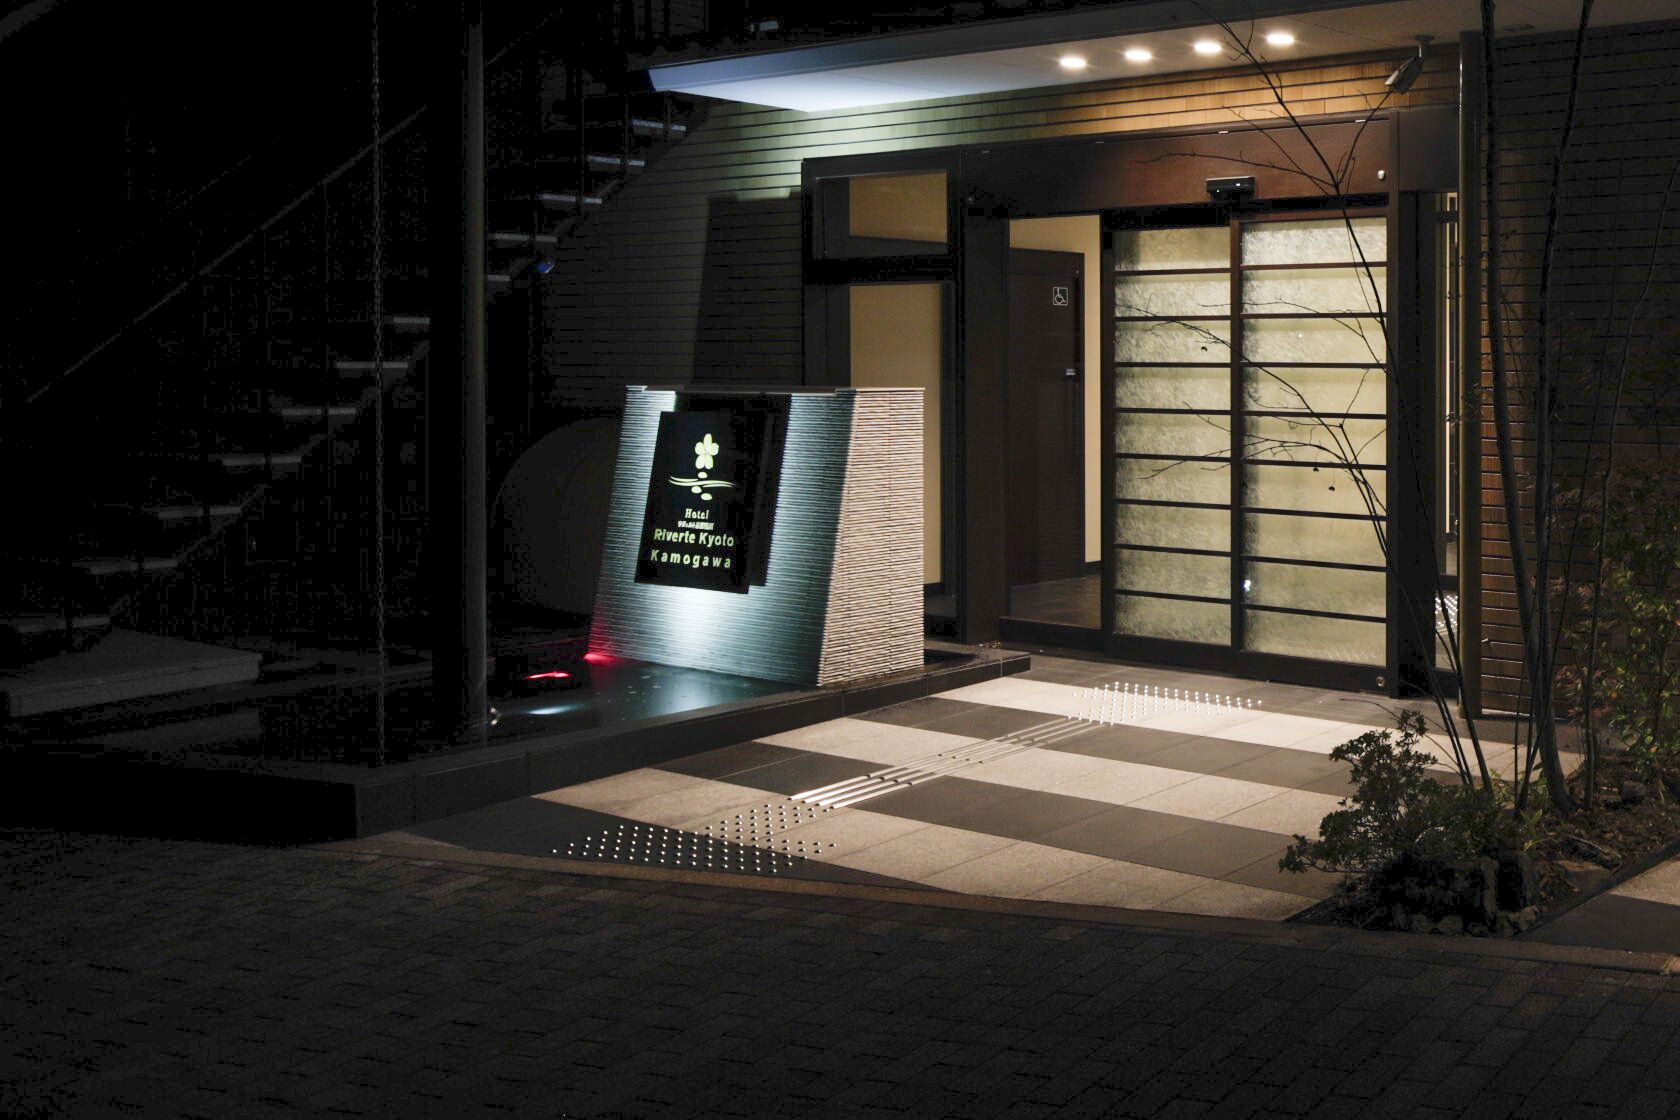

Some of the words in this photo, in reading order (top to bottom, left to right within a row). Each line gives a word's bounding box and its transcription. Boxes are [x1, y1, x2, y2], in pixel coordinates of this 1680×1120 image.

[684, 508, 710, 520] Hotel
[654, 528, 696, 544] Riverte
[698, 532, 734, 548] Kyoto
[650, 549, 731, 568] Kamogawa
